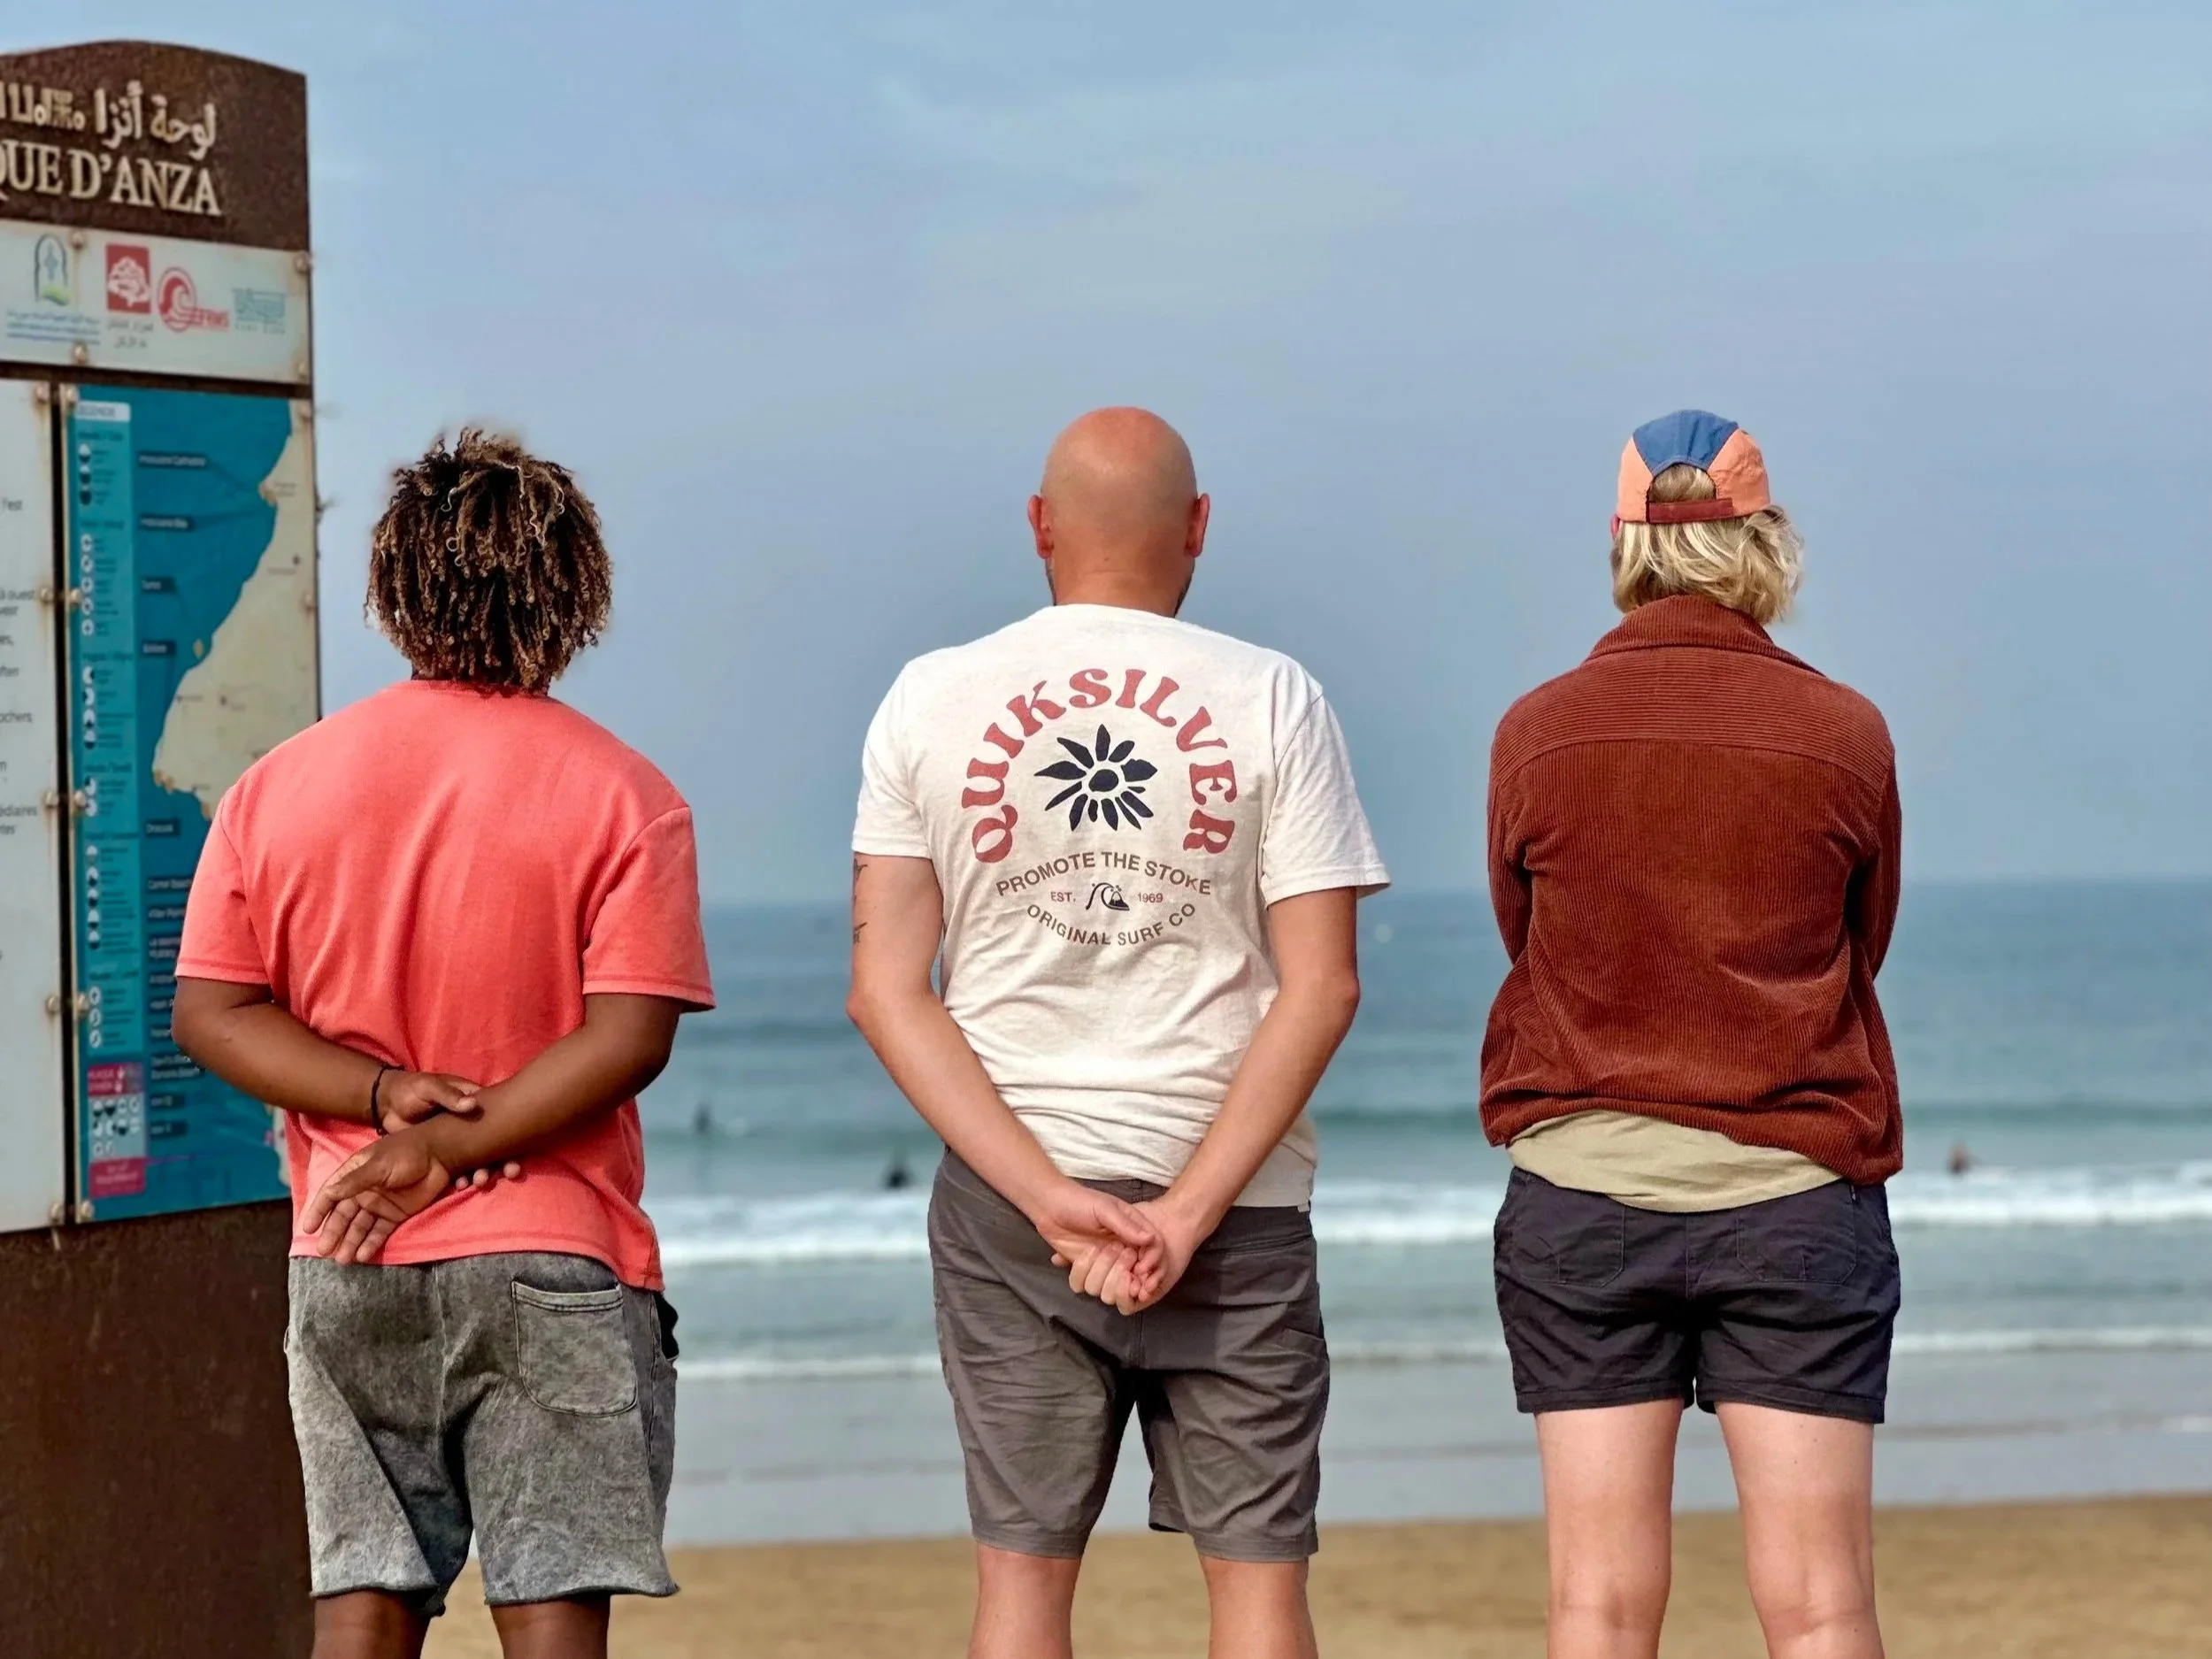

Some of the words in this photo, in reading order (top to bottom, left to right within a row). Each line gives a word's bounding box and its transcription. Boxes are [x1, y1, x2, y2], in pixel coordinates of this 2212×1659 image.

[94, 80, 144, 150] أنزا
[150, 94, 217, 161] لوحة
[67, 148, 222, 217] D'ANZA
[961, 668, 1238, 864] QUIKSILVER
[995, 852, 1095, 896] PROMOTE
[1102, 851, 1141, 872] THE
[1144, 860, 1211, 895] STOKE
[1050, 891, 1077, 902] EST.
[1138, 892, 1164, 903] 1969
[1026, 903, 1111, 946] ORIGINAL
[1117, 921, 1164, 946] SURF
[1169, 902, 1195, 927] CO
